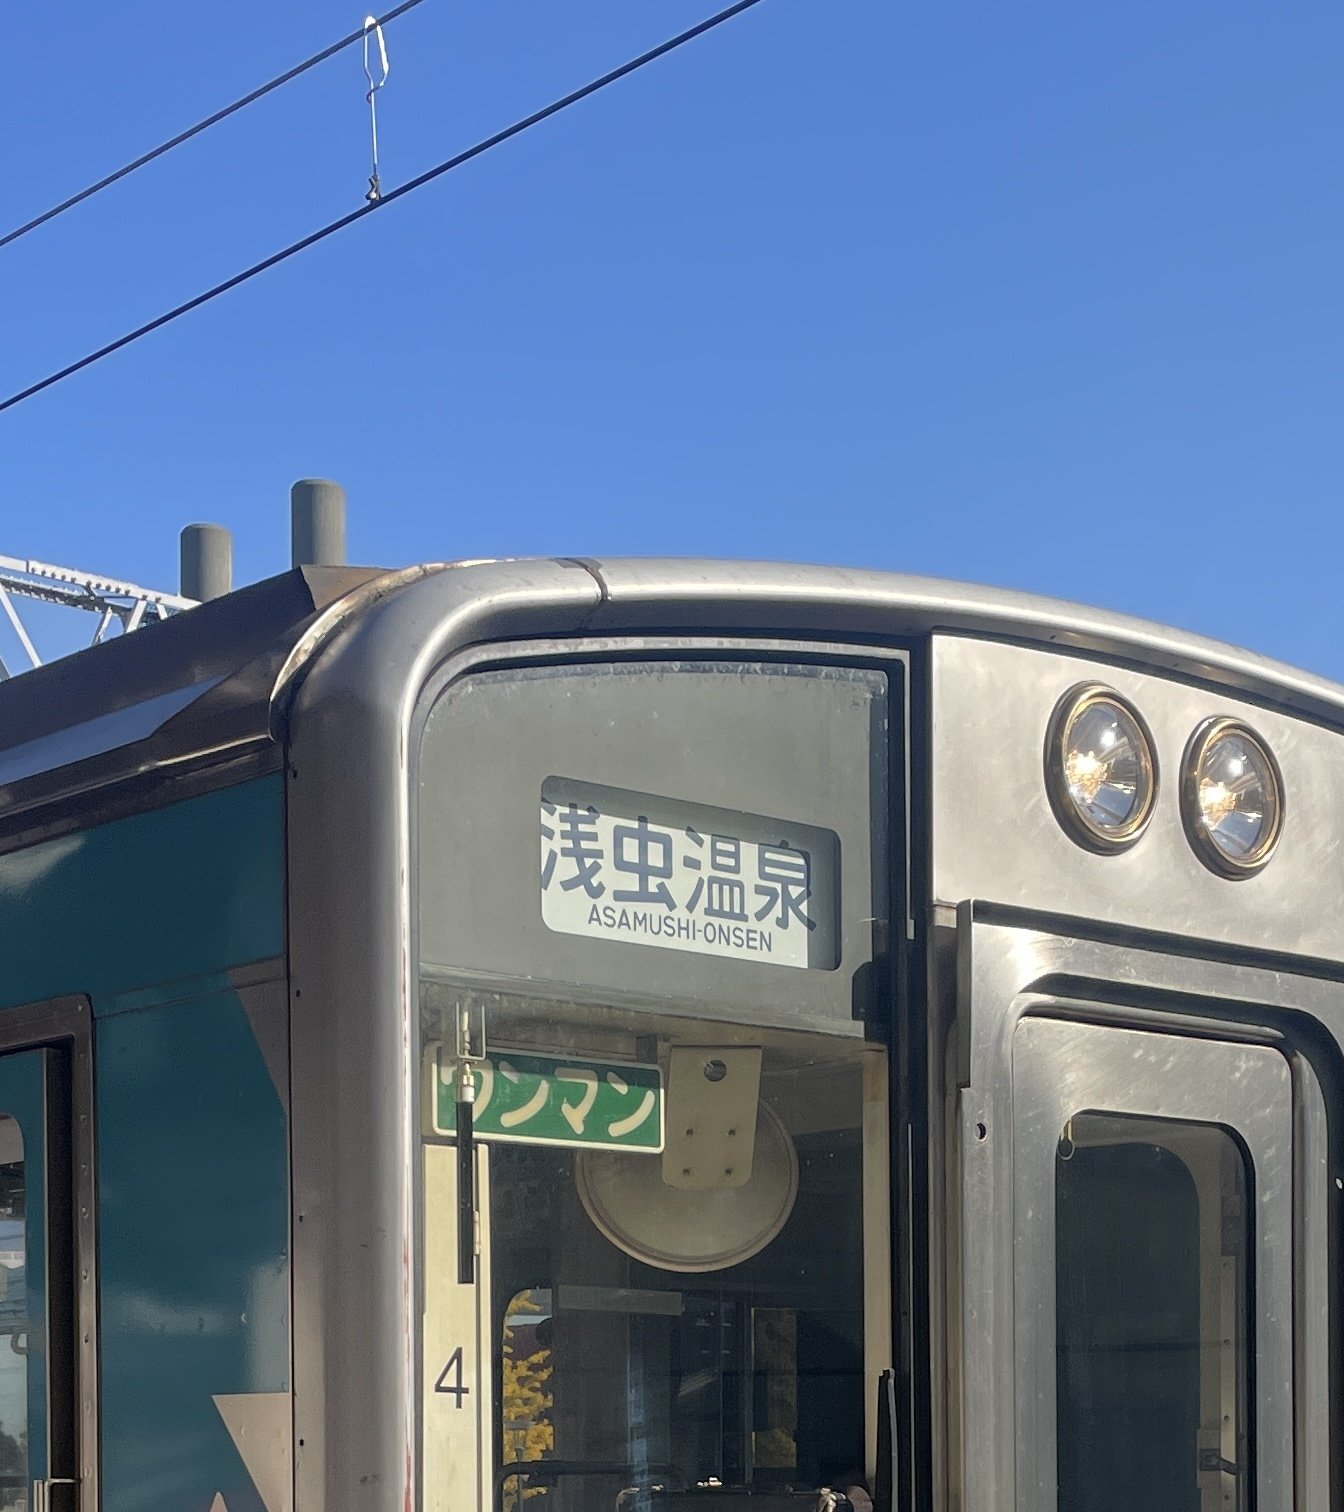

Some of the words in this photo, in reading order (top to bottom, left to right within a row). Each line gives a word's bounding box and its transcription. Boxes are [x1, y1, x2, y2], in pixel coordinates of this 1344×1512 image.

[541, 797, 817, 932] 浅虫温泉
[587, 903, 773, 953] ASAMUSHI-ONSEN
[434, 1346, 470, 1409] 4
